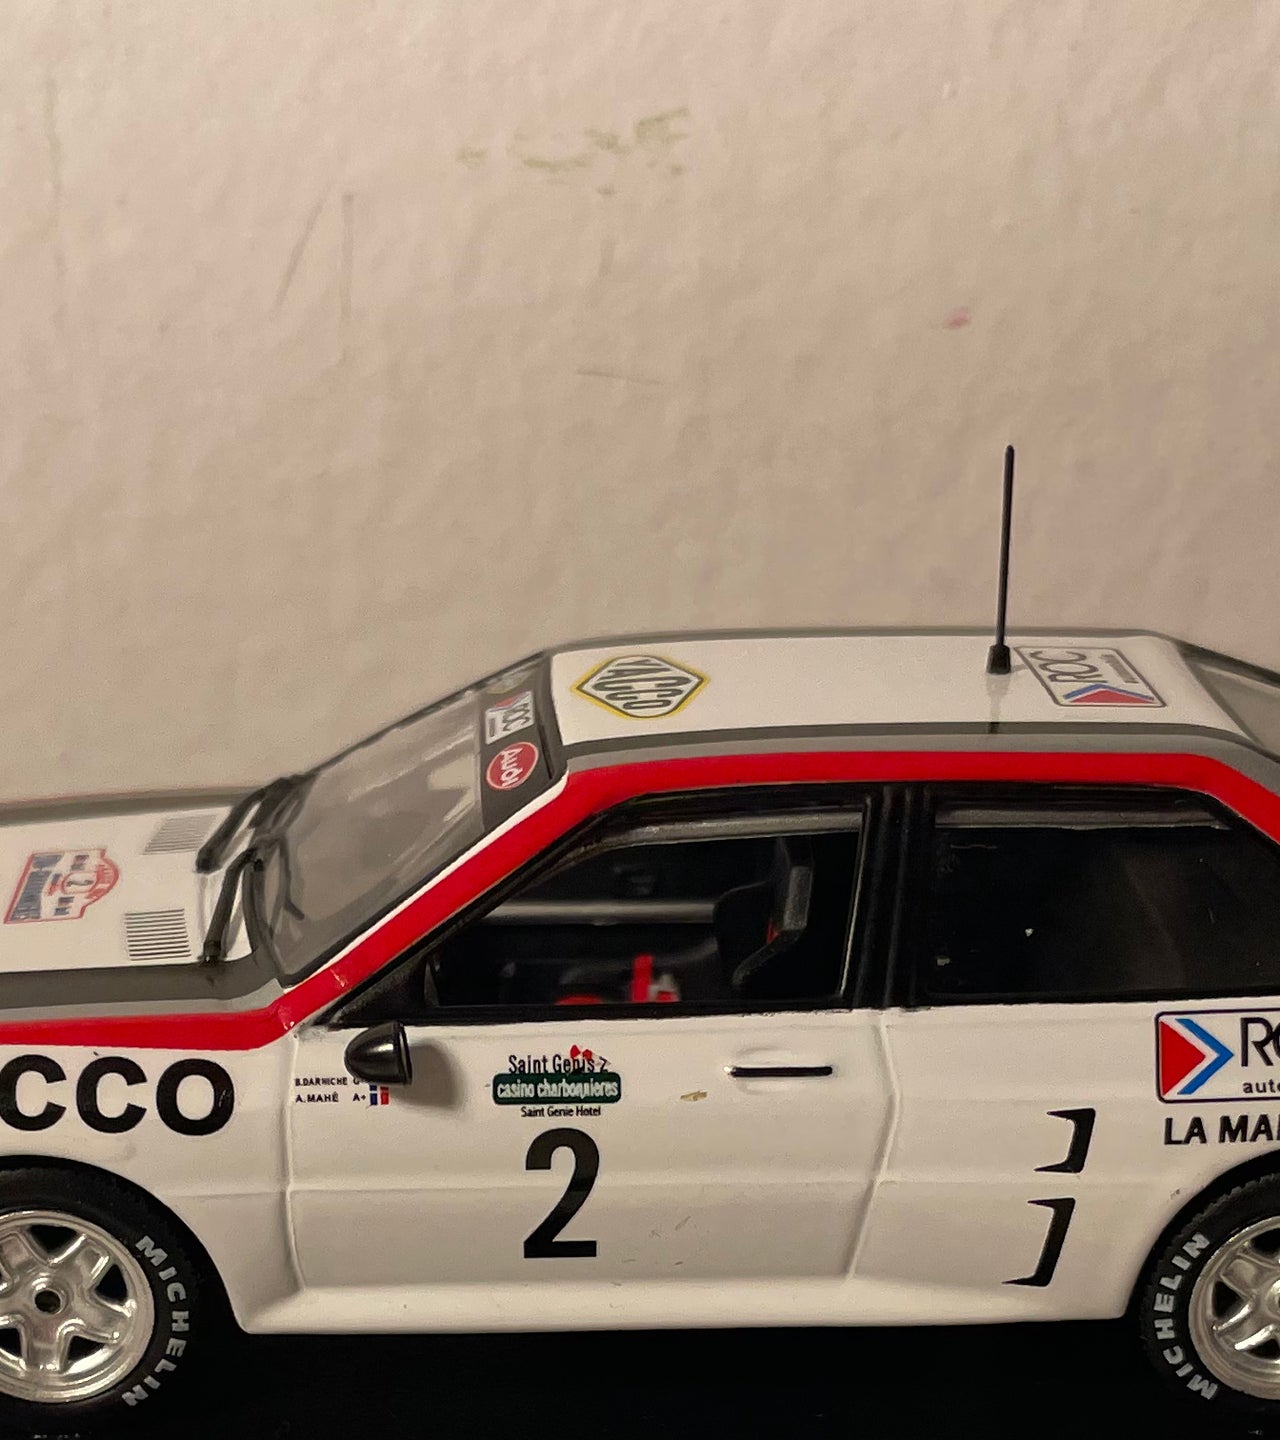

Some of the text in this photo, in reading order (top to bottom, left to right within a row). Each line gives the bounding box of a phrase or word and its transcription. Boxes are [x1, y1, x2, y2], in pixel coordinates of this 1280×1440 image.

[591, 658, 694, 711] YACCO
[508, 1054, 549, 1074] Saint
[496, 1078, 535, 1099] casino
[520, 1105, 545, 1118] Saint
[575, 1105, 602, 1117] Hotel
[1164, 1115, 1208, 1146] LA
[522, 1127, 600, 1259] 2
[121, 1234, 190, 1407] MICHELIN
[1153, 1231, 1219, 1401] MICHELIN
